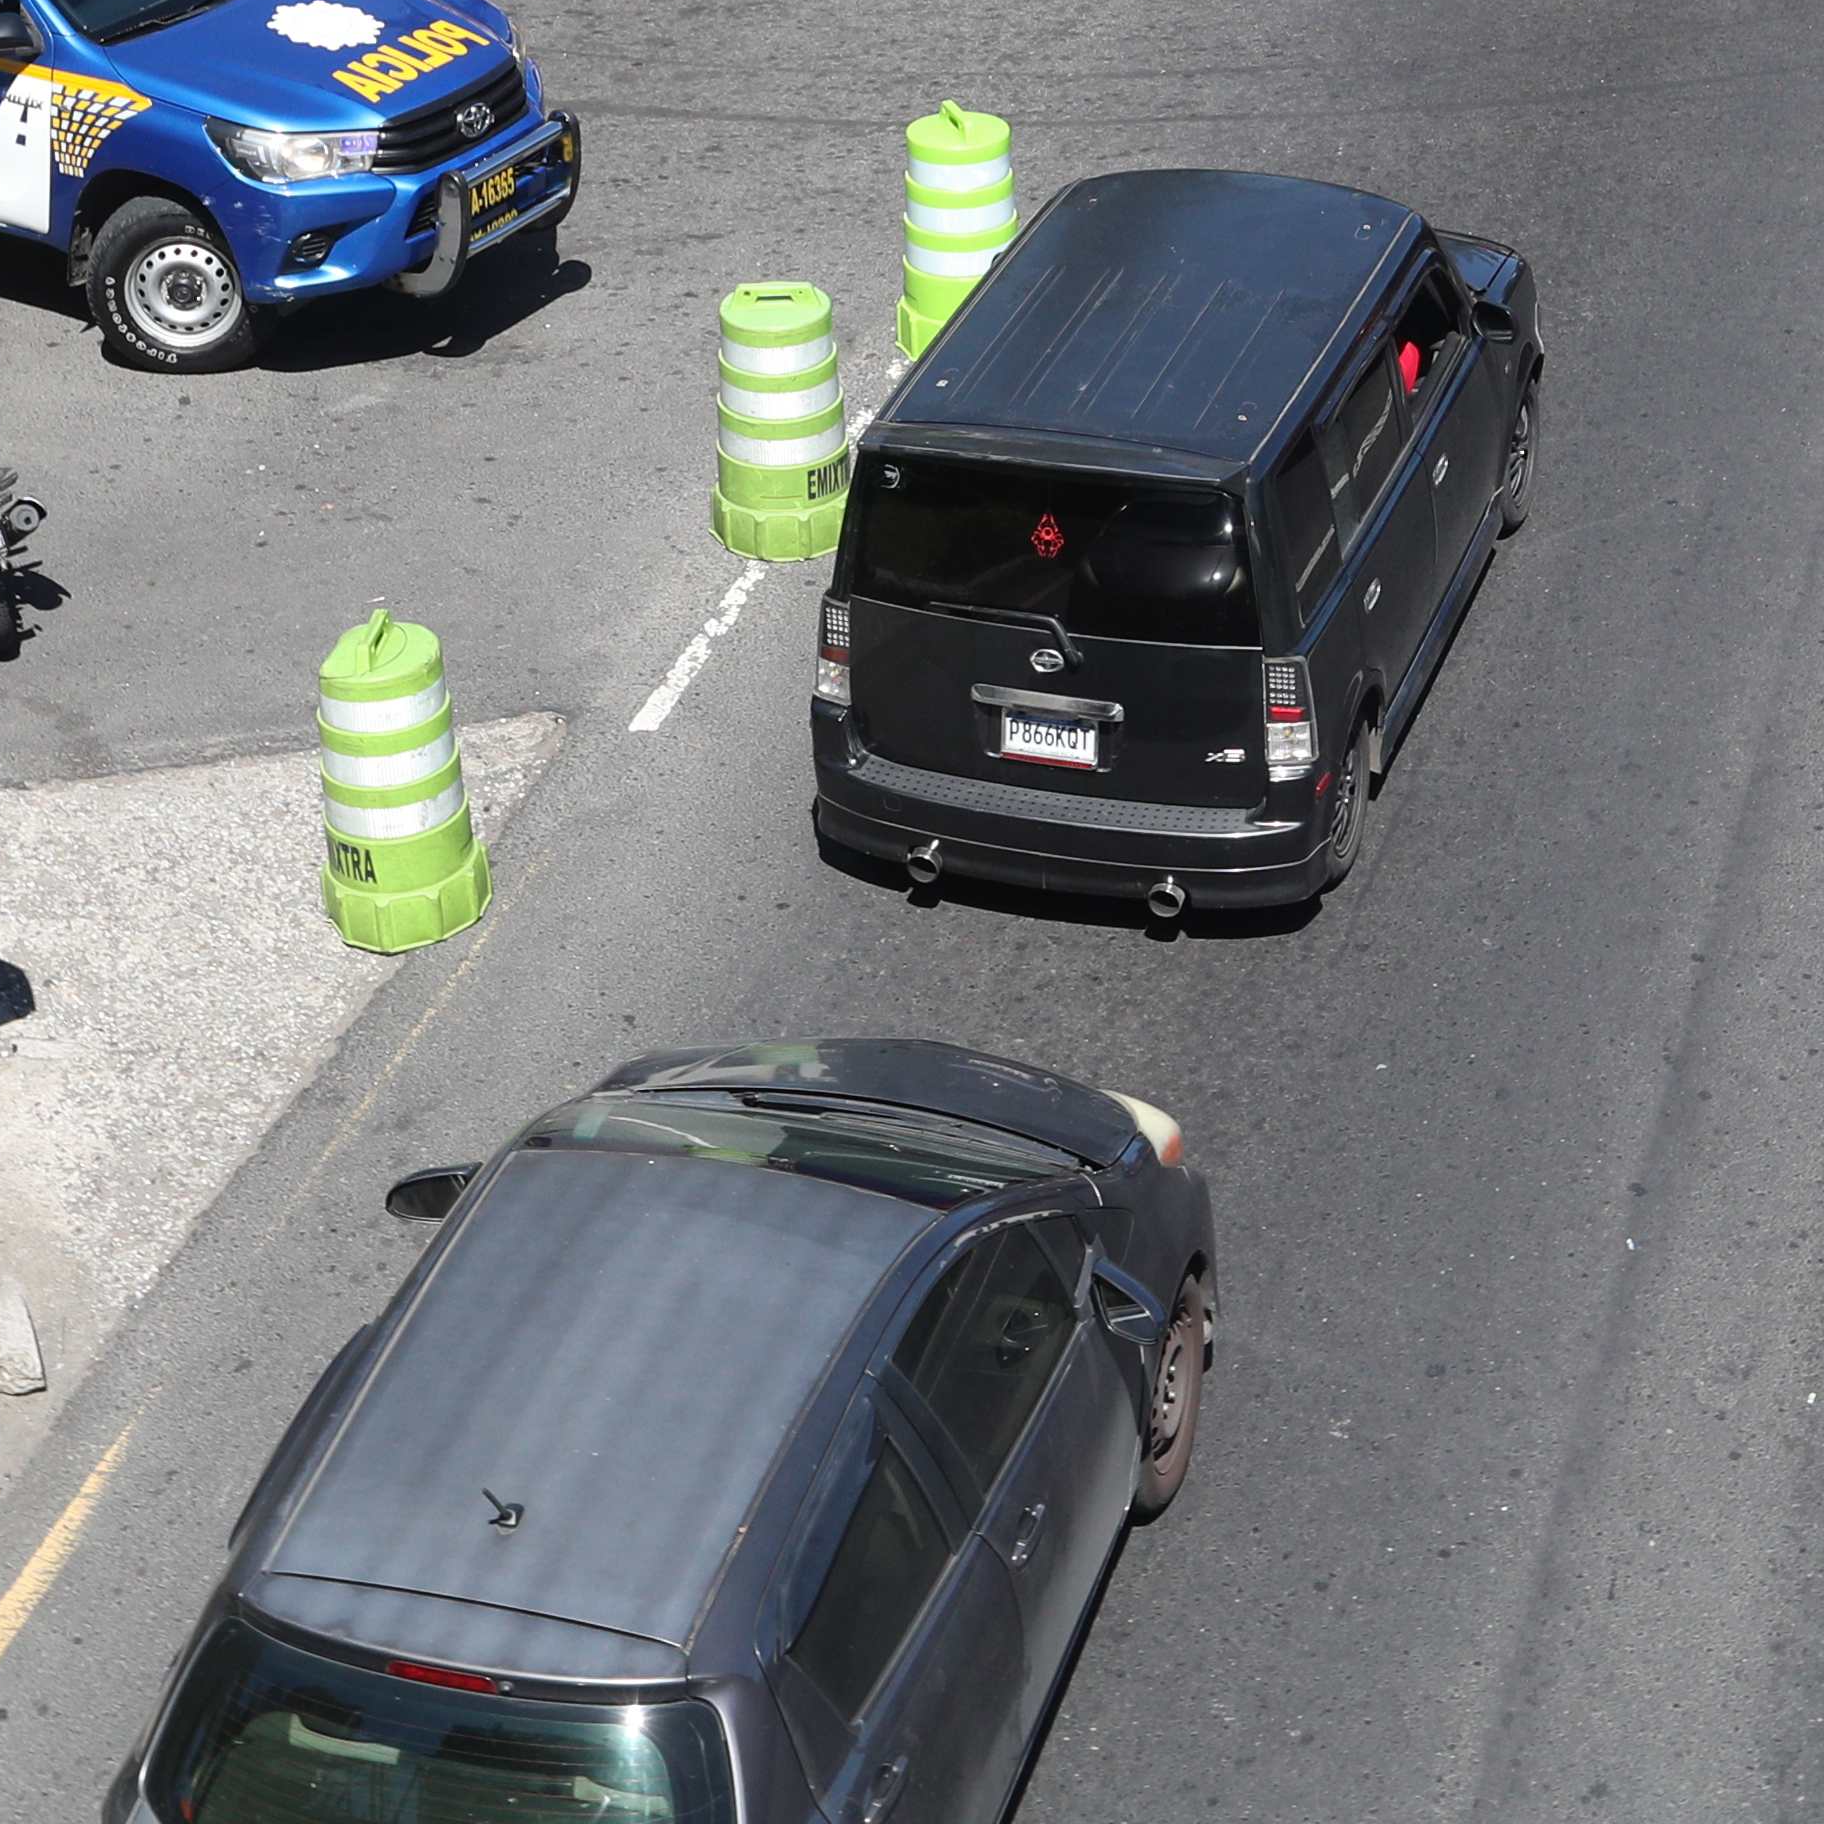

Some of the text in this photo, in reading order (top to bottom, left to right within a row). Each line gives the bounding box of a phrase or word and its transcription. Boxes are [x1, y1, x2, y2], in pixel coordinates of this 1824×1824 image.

[470, 166, 516, 217] A-16365
[1009, 719, 1091, 751] P866KQT
[330, 840, 378, 885] XTRA
